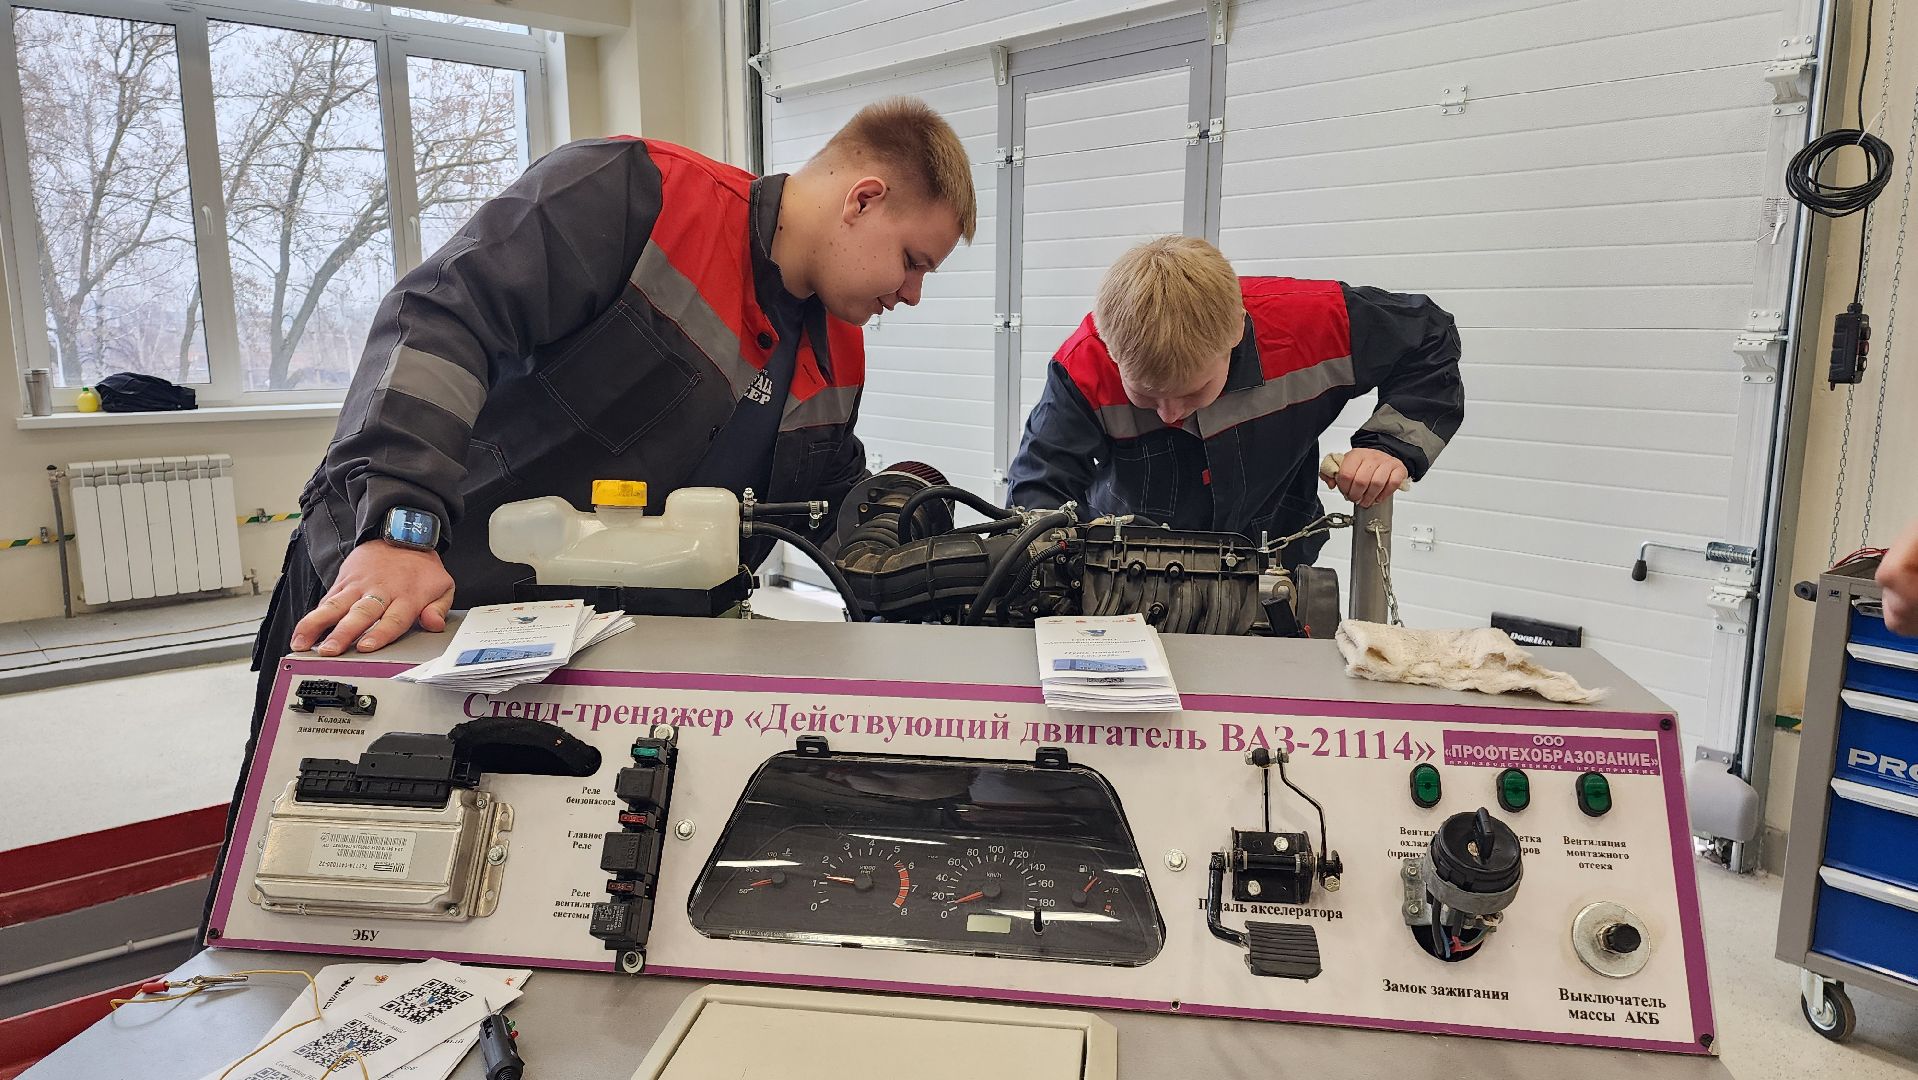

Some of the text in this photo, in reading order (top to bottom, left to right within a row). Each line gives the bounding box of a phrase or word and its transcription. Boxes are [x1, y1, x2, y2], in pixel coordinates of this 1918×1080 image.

[317, 715, 351, 724] Колодка
[297, 726, 365, 735] диагностическая
[463, 693, 1436, 761] Стенд-тренажер «Действующий двигатель ВАЗ-21114»
[1533, 735, 1565, 747] ООО
[1445, 744, 1658, 767] «ПРОФТЕХОБРАЗОВАНИЕ»
[1449, 760, 1655, 775] ПРОИЗВОДСТВЕННОЕ ПРЕДПРИЯТИЕ
[582, 786, 601, 795] Реле
[566, 796, 616, 806] бензонасоса
[567, 830, 602, 840] Главное
[1399, 826, 1436, 837] Вентил
[869, 839, 875, 847] 4
[1519, 835, 1542, 843] етка
[1563, 836, 1627, 848] Вентиляция
[572, 841, 592, 850] Реле
[1400, 840, 1429, 848] охлаж
[894, 845, 900, 853] 5
[966, 848, 979, 856] 80
[988, 845, 1004, 854] 100
[1522, 847, 1541, 856] ров
[1013, 850, 1029, 858] 120
[1387, 849, 1426, 859] (прину
[1566, 849, 1630, 860] монтажного
[822, 855, 829, 863] 2
[948, 858, 961, 866] 60
[1029, 863, 1045, 871] 140
[1579, 861, 1613, 871] отсека
[935, 874, 948, 882] 40
[813, 879, 817, 887] 1
[1038, 880, 1054, 888] 160
[571, 888, 591, 897] Реле
[912, 885, 918, 893] 7
[932, 892, 945, 900] 20
[555, 900, 596, 909] вентилят
[811, 902, 817, 911] 0
[1039, 898, 1055, 907] 180
[553, 911, 590, 920] системы
[901, 908, 908, 916] 8
[1251, 903, 1343, 921] акселератора
[352, 929, 380, 941] ЭБУ
[1382, 978, 1509, 1001] Замок зажигания
[1558, 988, 1667, 1009] Выключатель
[1568, 1007, 1660, 1025] массы АКБ
